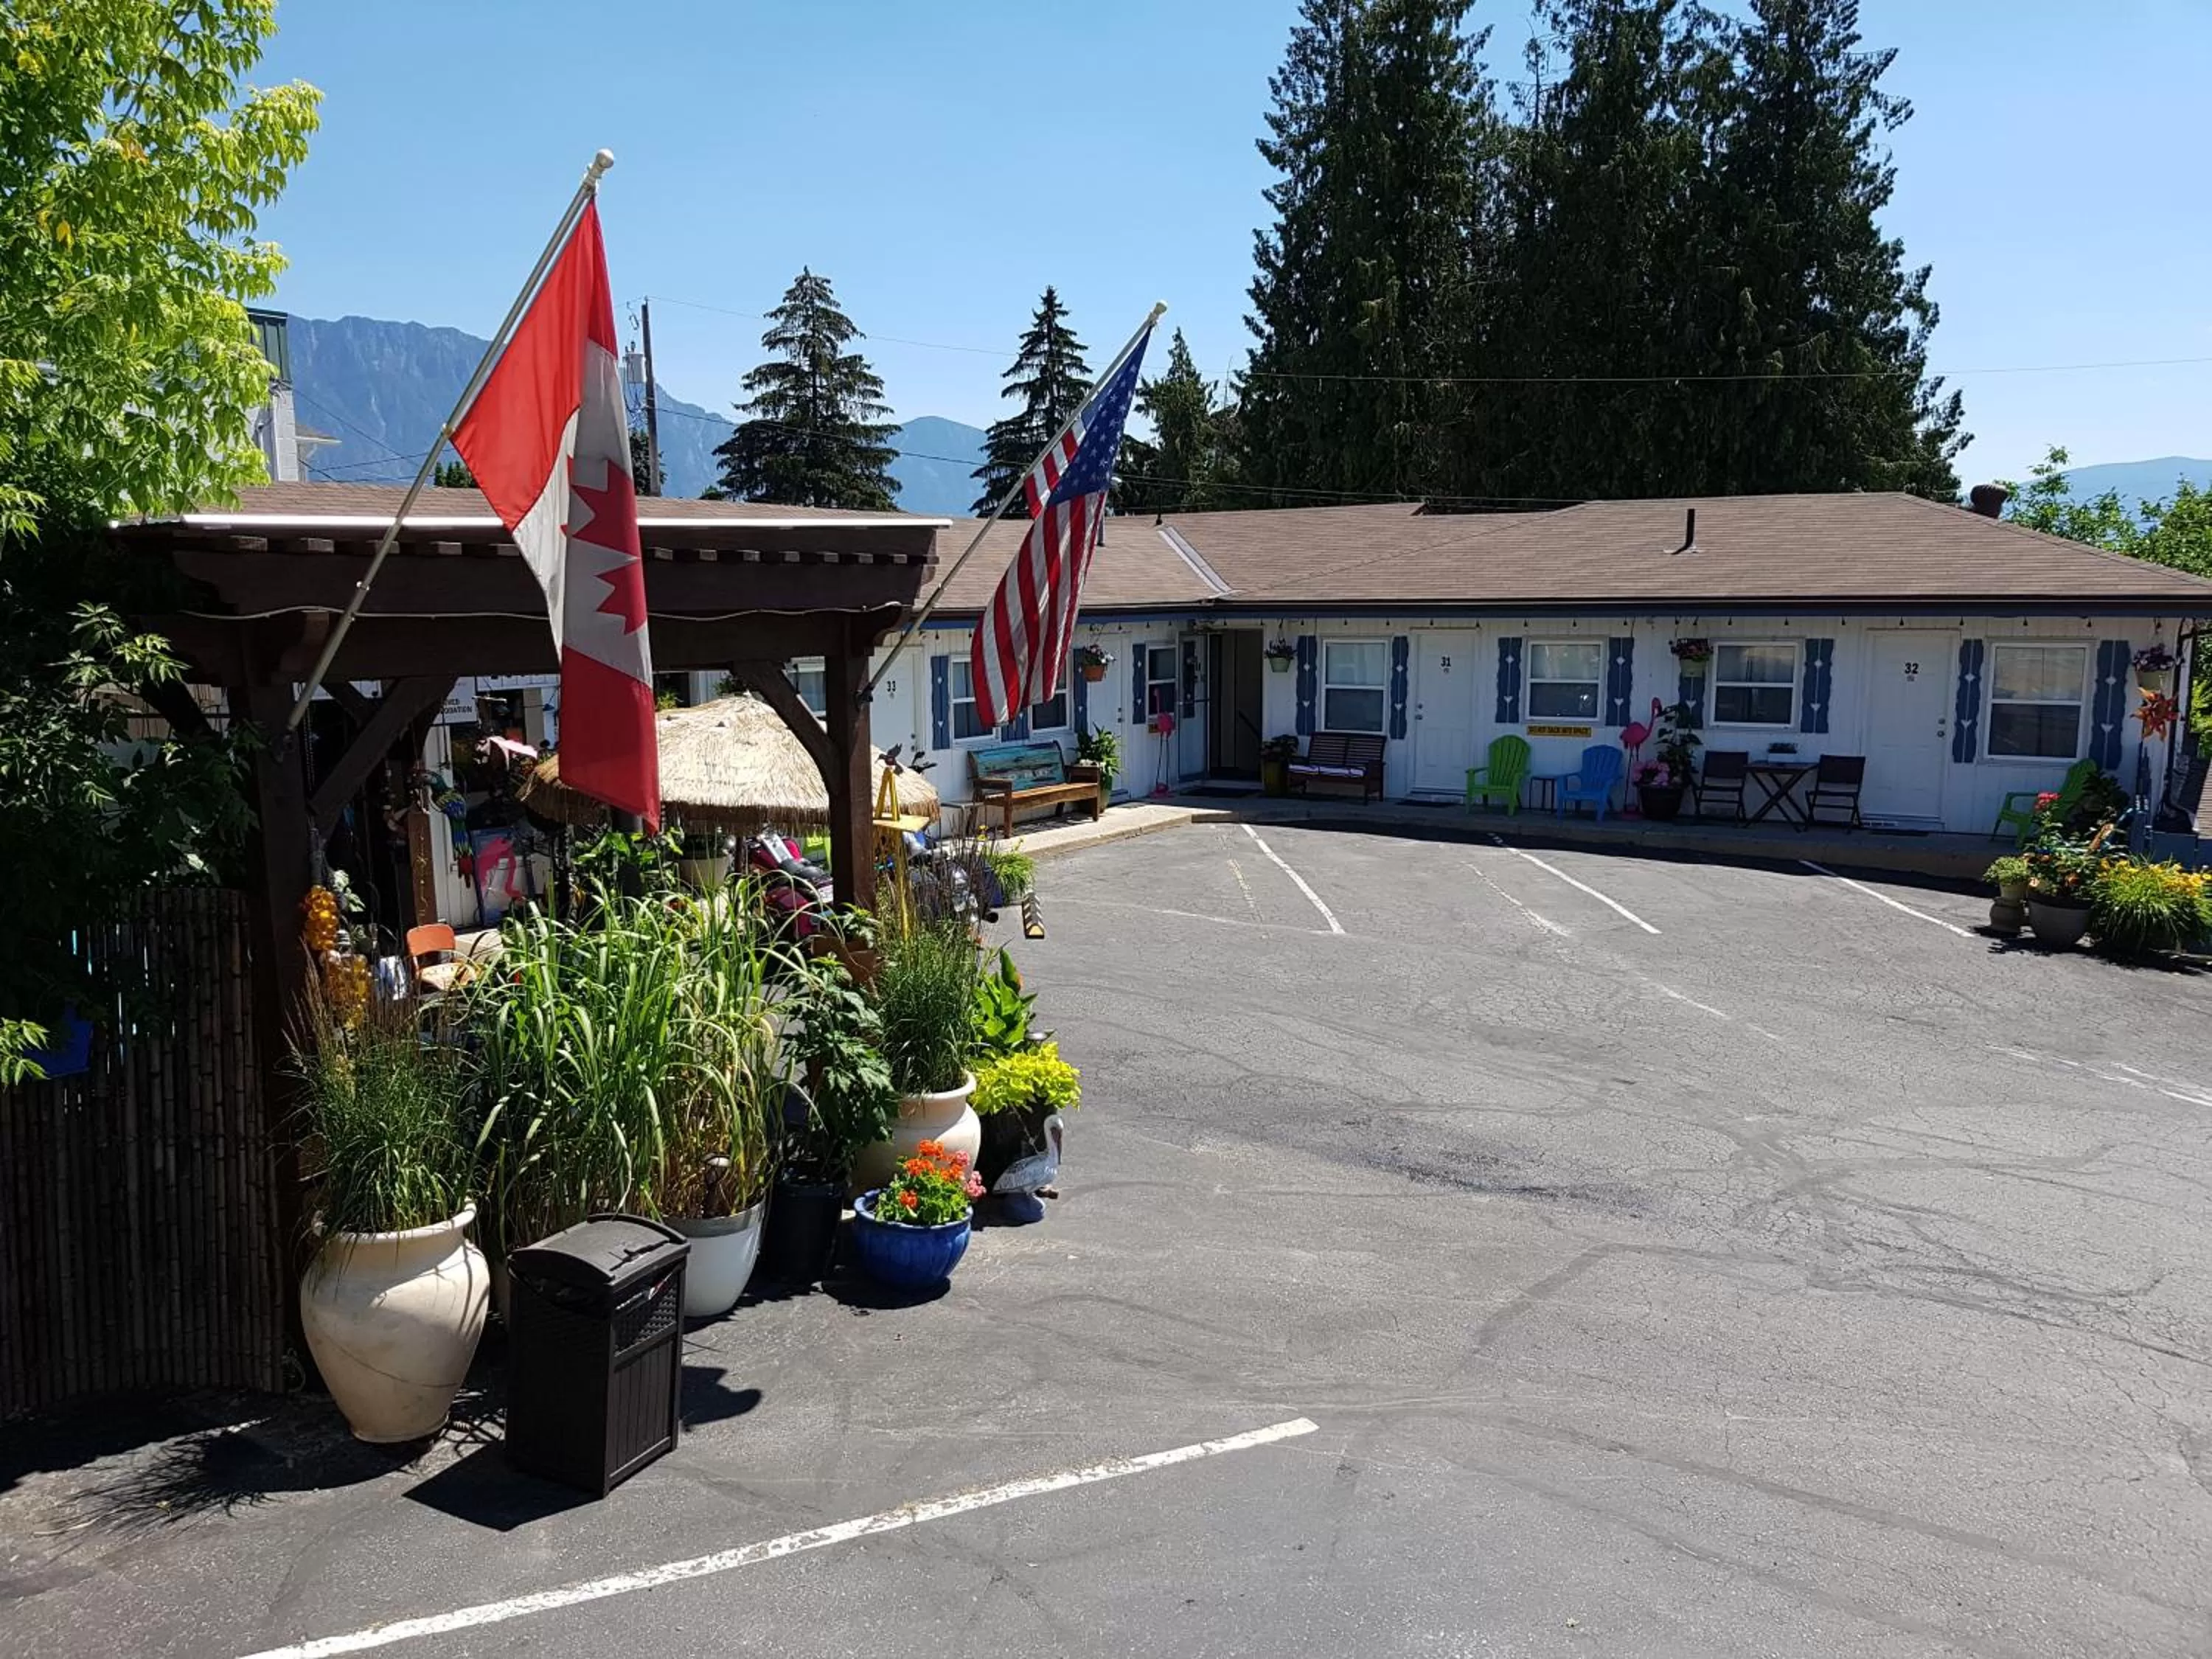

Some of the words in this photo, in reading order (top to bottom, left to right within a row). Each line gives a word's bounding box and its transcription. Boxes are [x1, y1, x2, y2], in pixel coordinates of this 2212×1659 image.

[1441, 656, 1452, 667] 31
[1905, 663, 1919, 674] 32
[887, 681, 896, 692] 33
